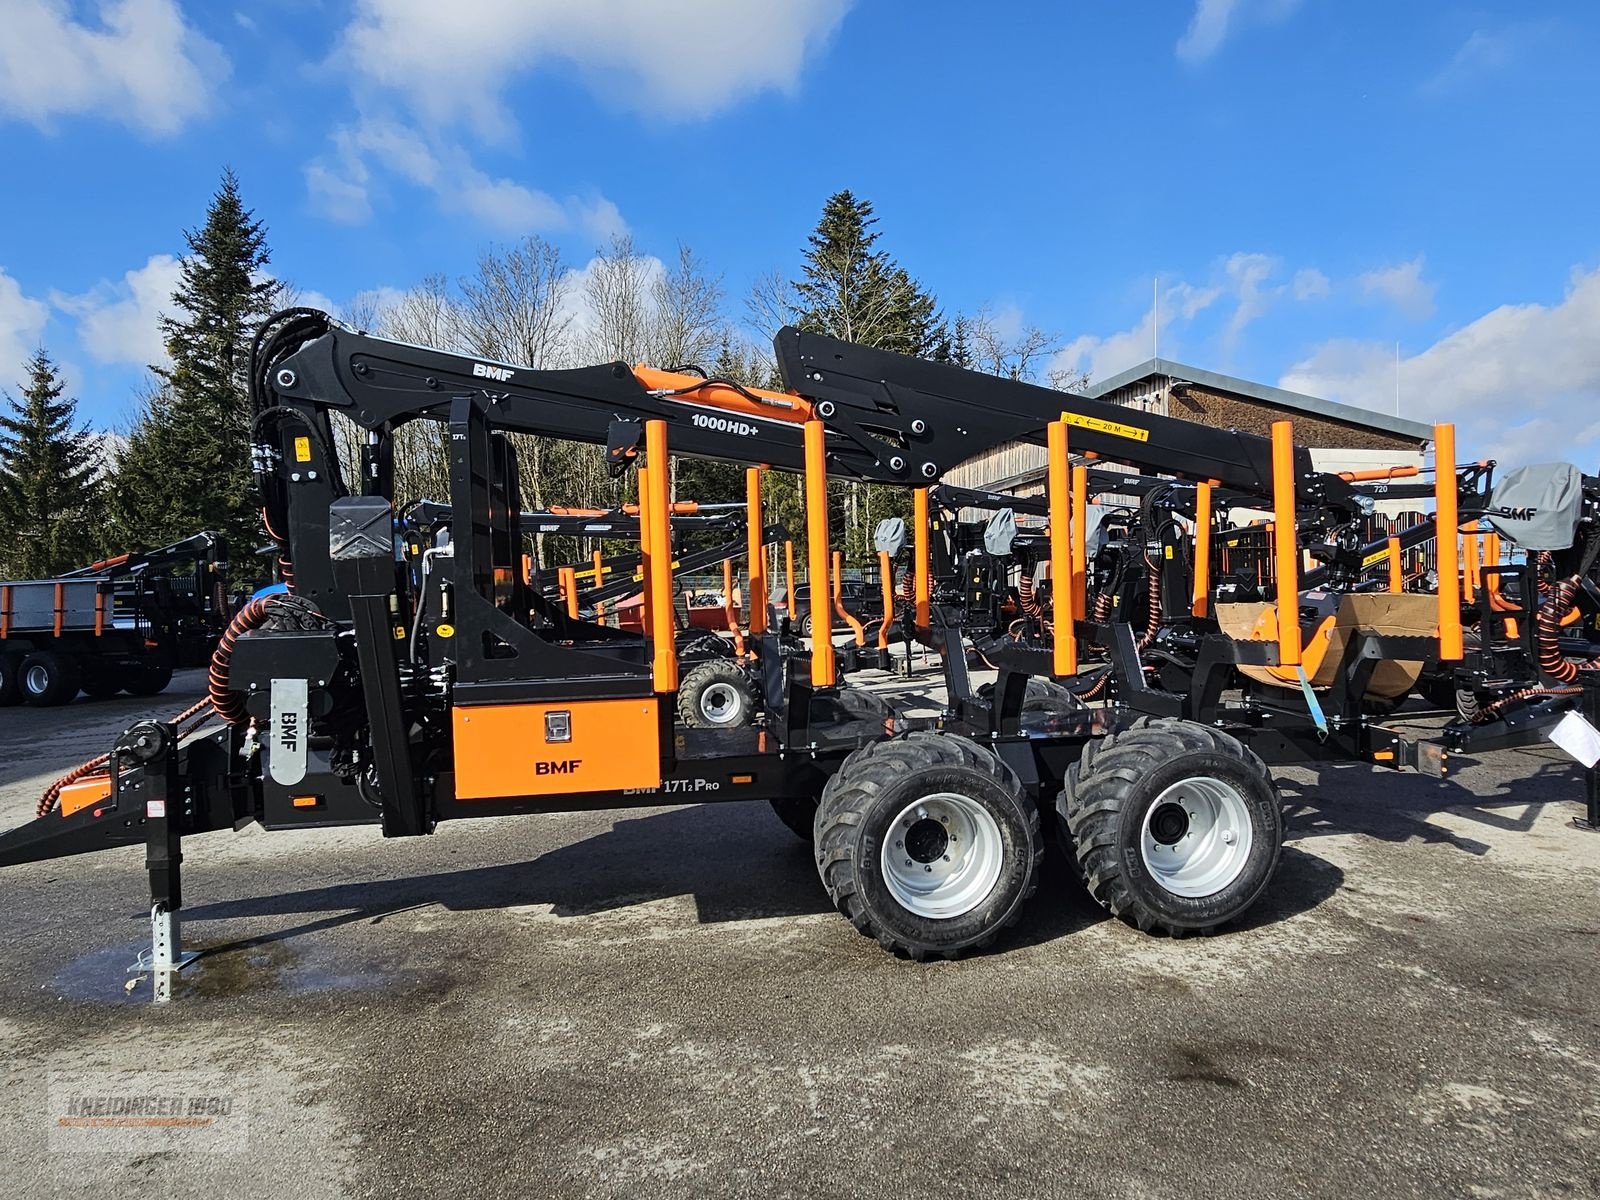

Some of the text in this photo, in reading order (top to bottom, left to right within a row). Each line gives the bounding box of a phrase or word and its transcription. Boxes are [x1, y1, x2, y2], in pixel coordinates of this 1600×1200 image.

[472, 363, 515, 382] BMF
[691, 414, 759, 436] 1000HD+
[1102, 423, 1113, 431] 20
[1373, 485, 1388, 493] 720
[281, 712, 298, 752] BMF
[535, 760, 583, 775] BMF
